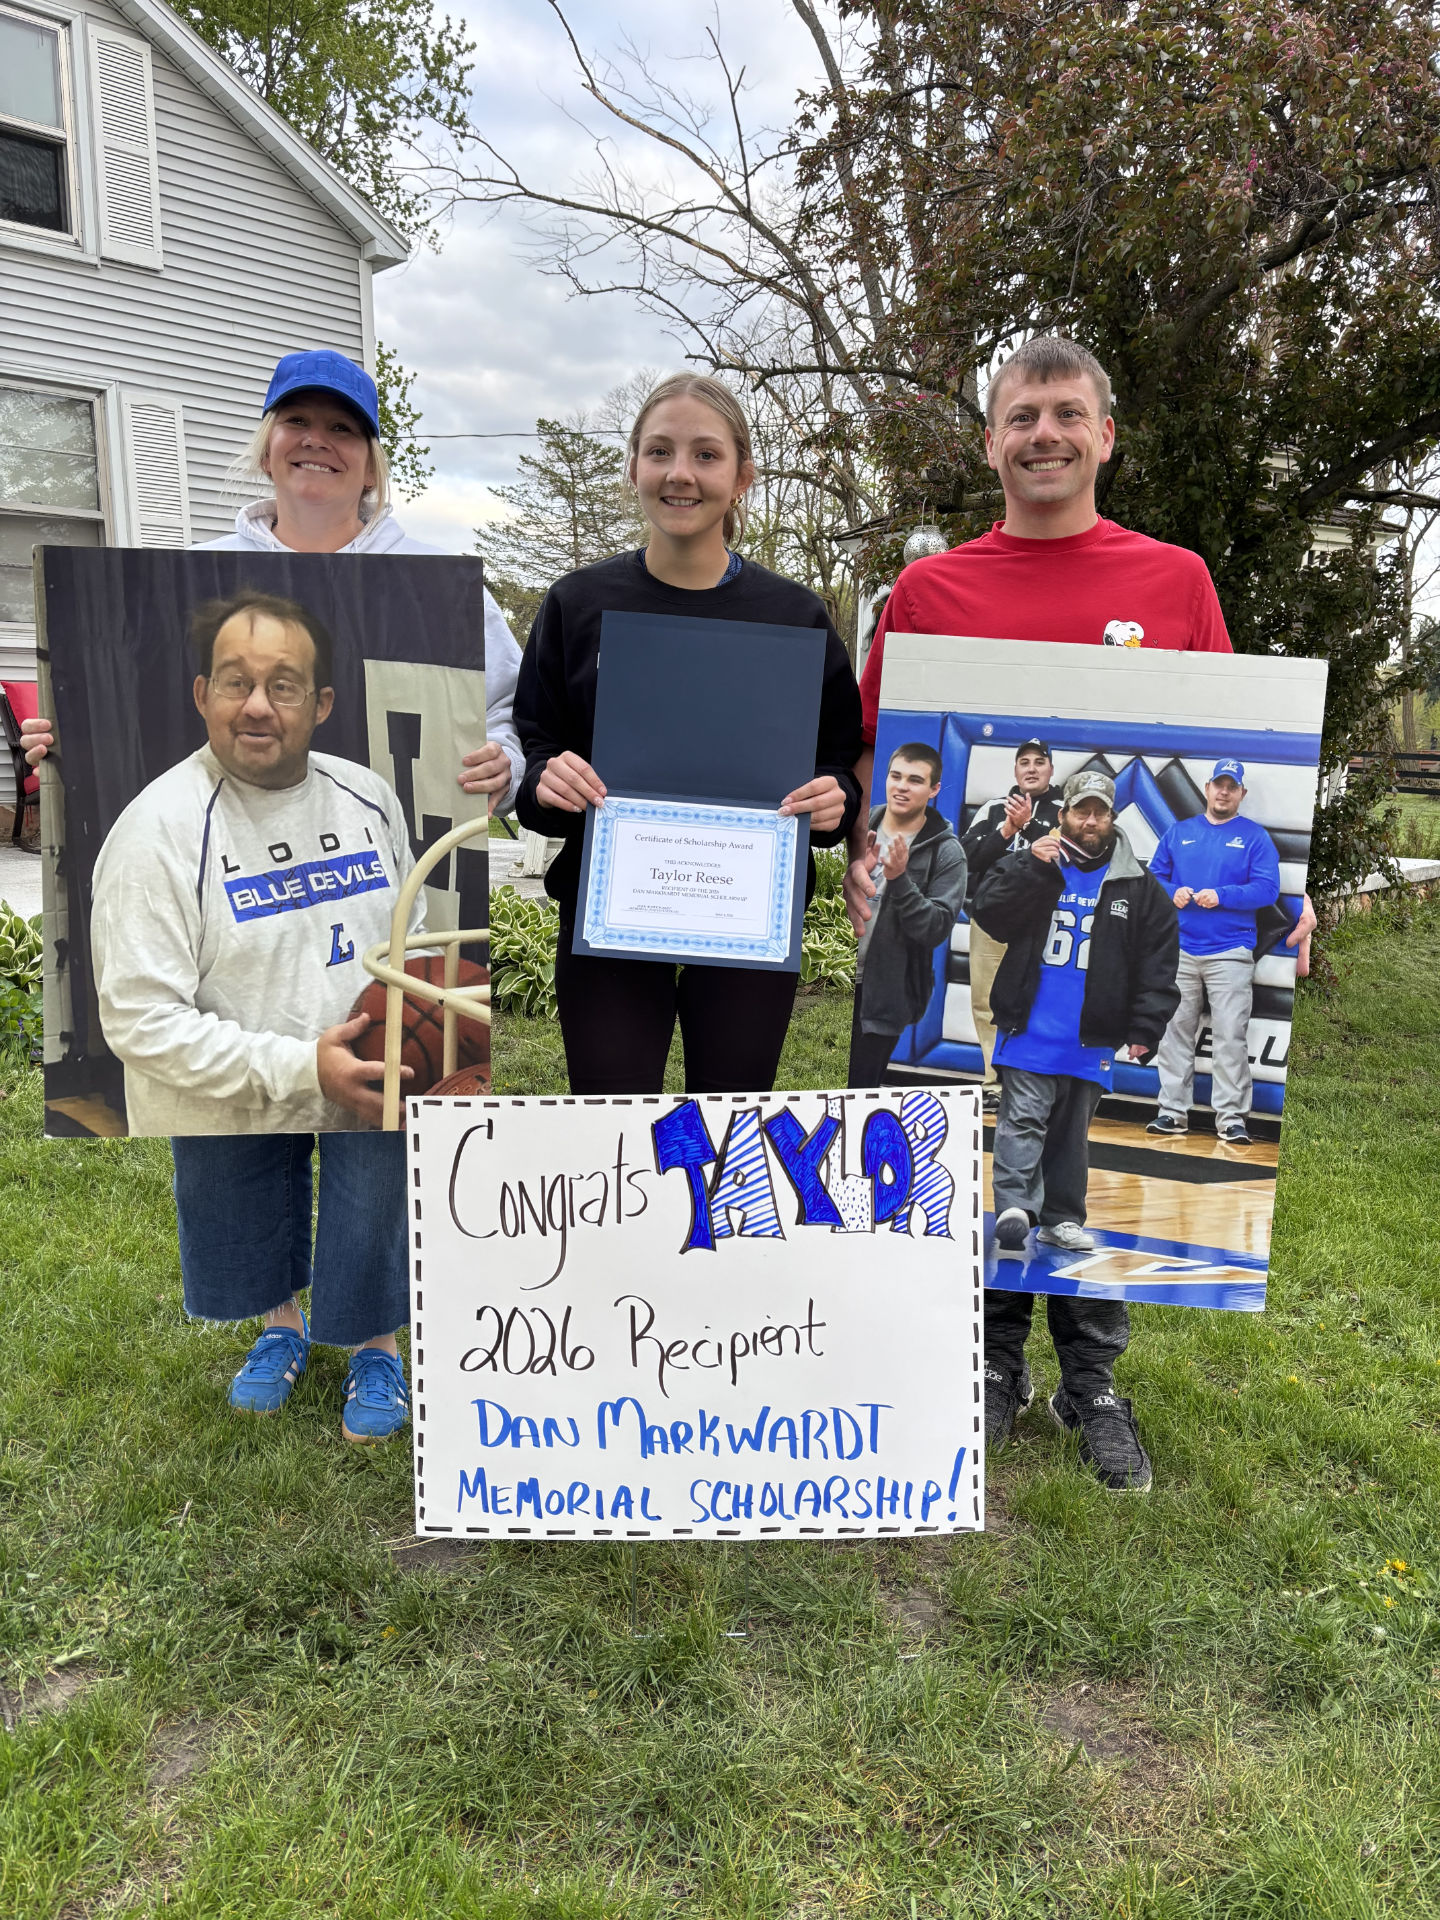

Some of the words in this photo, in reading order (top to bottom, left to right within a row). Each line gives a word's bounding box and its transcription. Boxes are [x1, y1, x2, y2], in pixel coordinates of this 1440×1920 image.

[221, 827, 374, 874] LODI
[634, 833, 673, 844] Certificate
[674, 837, 683, 845] of
[683, 837, 727, 850] Scholarship
[728, 841, 753, 850] Award
[231, 876, 307, 912] BLUE
[308, 860, 385, 893] DEVILS
[649, 867, 693, 884] Taylor
[696, 871, 734, 885] Reese
[651, 1091, 955, 1252] TAYLOR
[459, 1304, 596, 1377] 2026
[613, 1294, 827, 1399] Recipient
[472, 1398, 581, 1449] DAN
[596, 1396, 896, 1461] MARKWARDT
[456, 1466, 663, 1522] MEMORIAL
[689, 1446, 968, 1523] SCHOLARSHIP!
